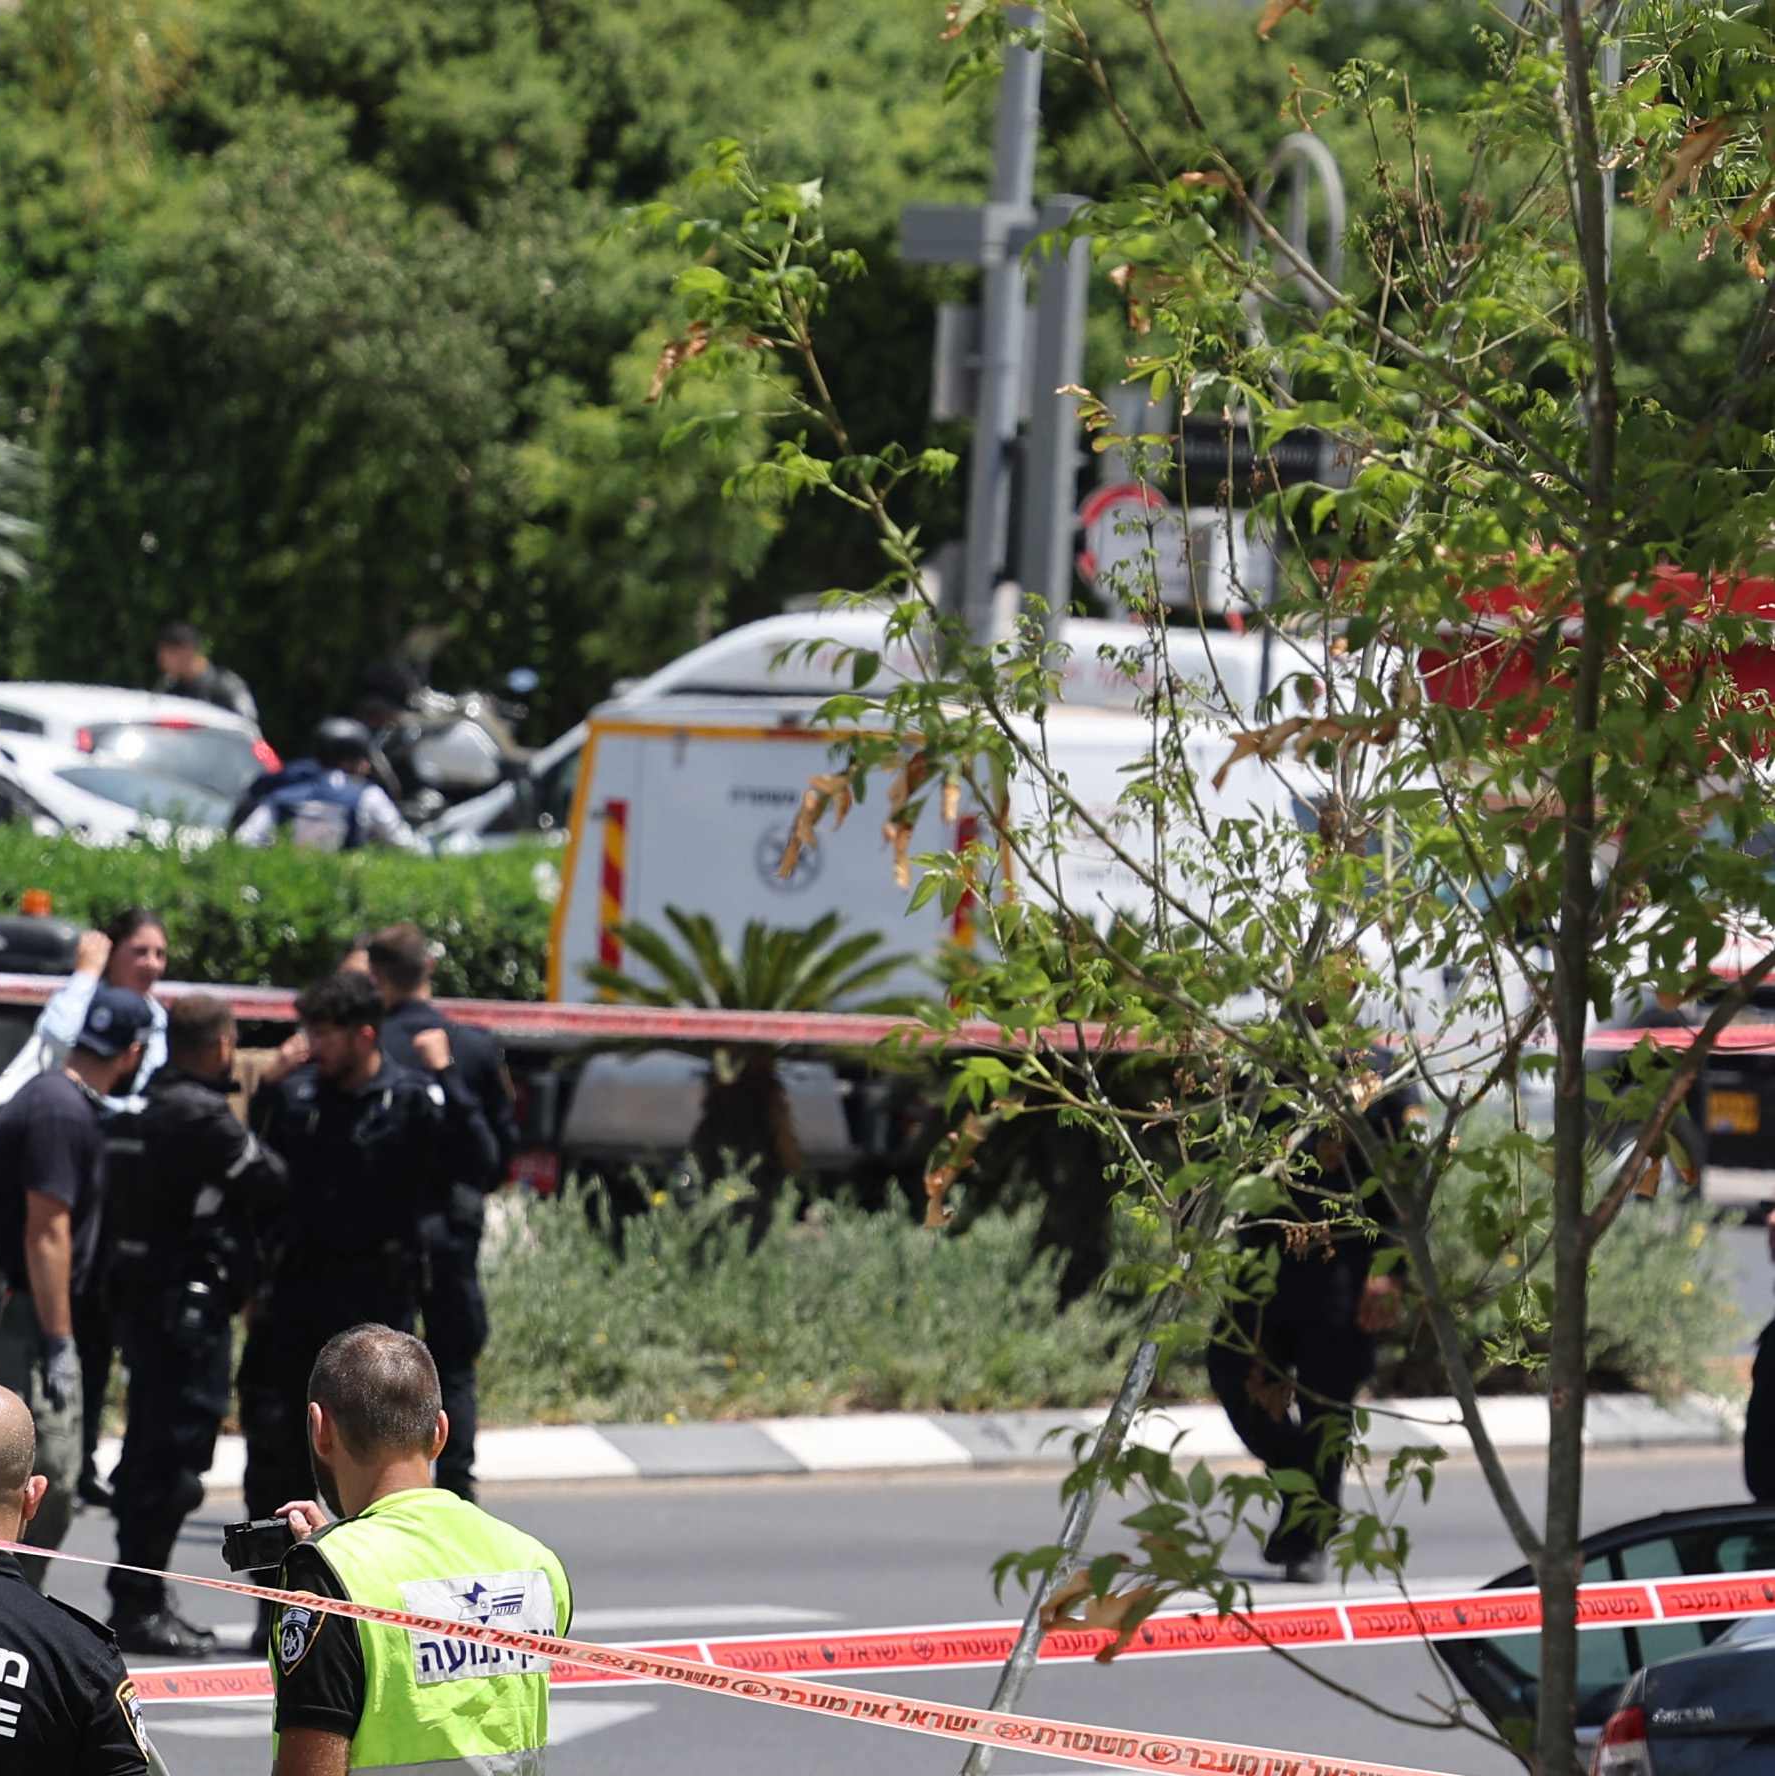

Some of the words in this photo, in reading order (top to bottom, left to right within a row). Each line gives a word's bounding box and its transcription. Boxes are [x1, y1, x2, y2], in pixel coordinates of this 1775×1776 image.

[444, 1622, 484, 1640] אין
[489, 1629, 572, 1656] ישראל
[1260, 1616, 1330, 1642] משטרת
[941, 1635, 1013, 1660] משטרת
[623, 1657, 730, 1690] משטרת
[773, 1686, 849, 1713] מעבר
[852, 1695, 889, 1720] אין
[894, 1702, 979, 1736] ישראל
[1035, 1725, 1139, 1760] משטרת
